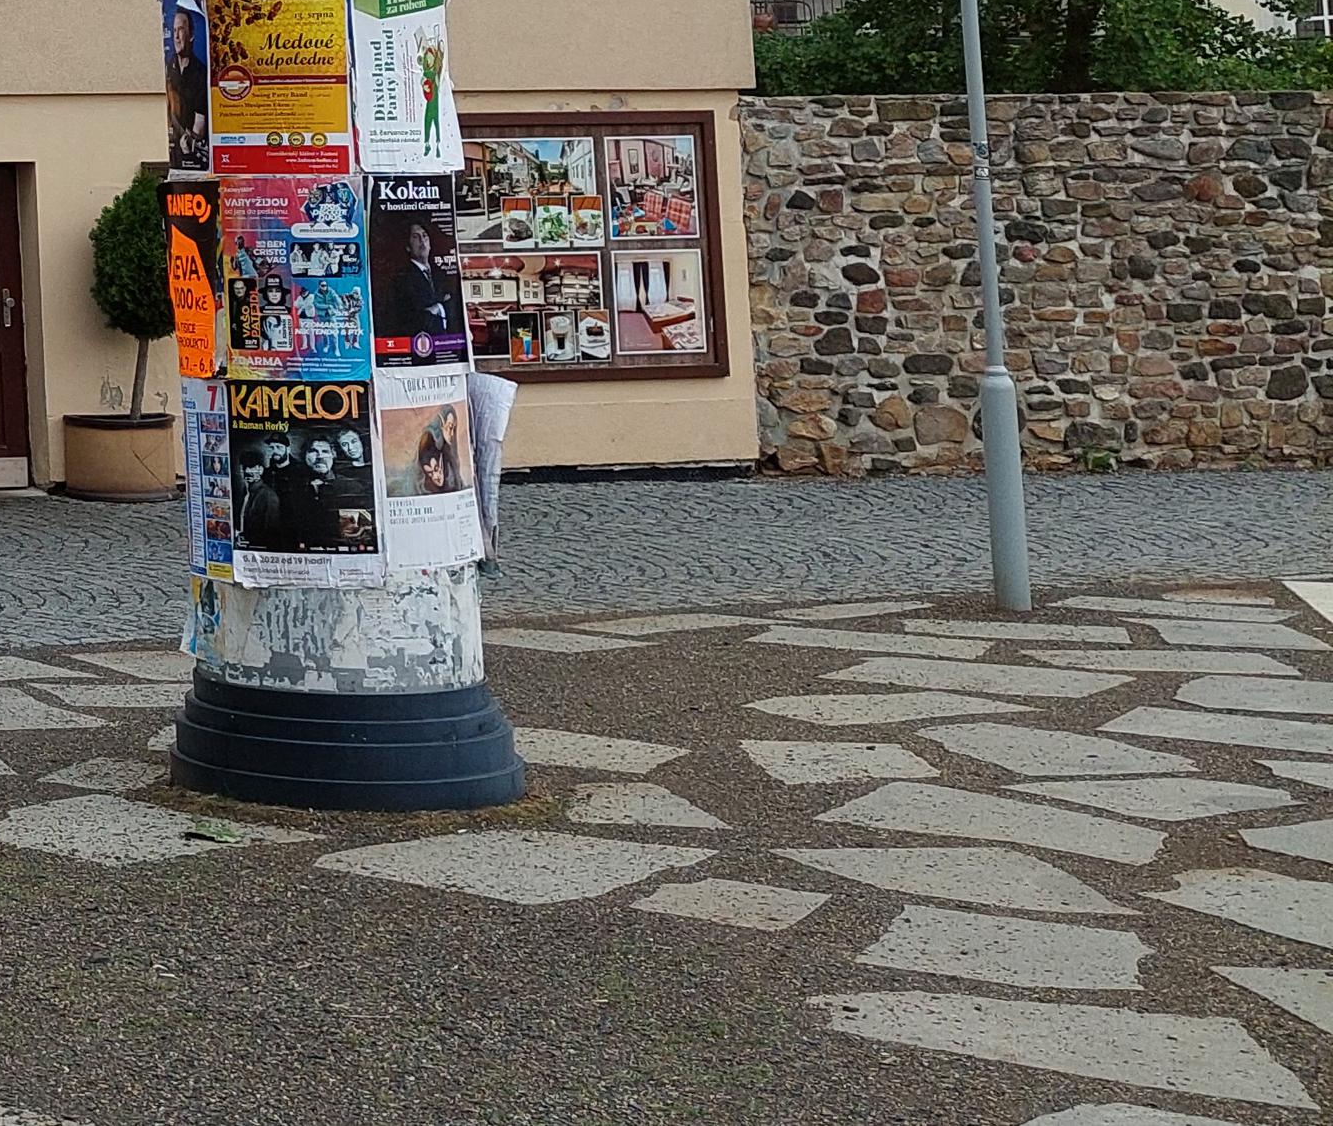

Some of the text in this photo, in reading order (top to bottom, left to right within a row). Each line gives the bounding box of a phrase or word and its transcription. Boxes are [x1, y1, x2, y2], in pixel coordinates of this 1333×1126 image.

[386, 5, 398, 15] za
[259, 32, 334, 51] Medové
[256, 51, 334, 70] odpoledne
[370, 40, 386, 122] Dixieland
[382, 29, 399, 122] Party Band
[378, 180, 440, 200] Kokain
[194, 294, 209, 312] Kč
[207, 385, 218, 411] 7
[230, 384, 365, 420] KAMELOT
